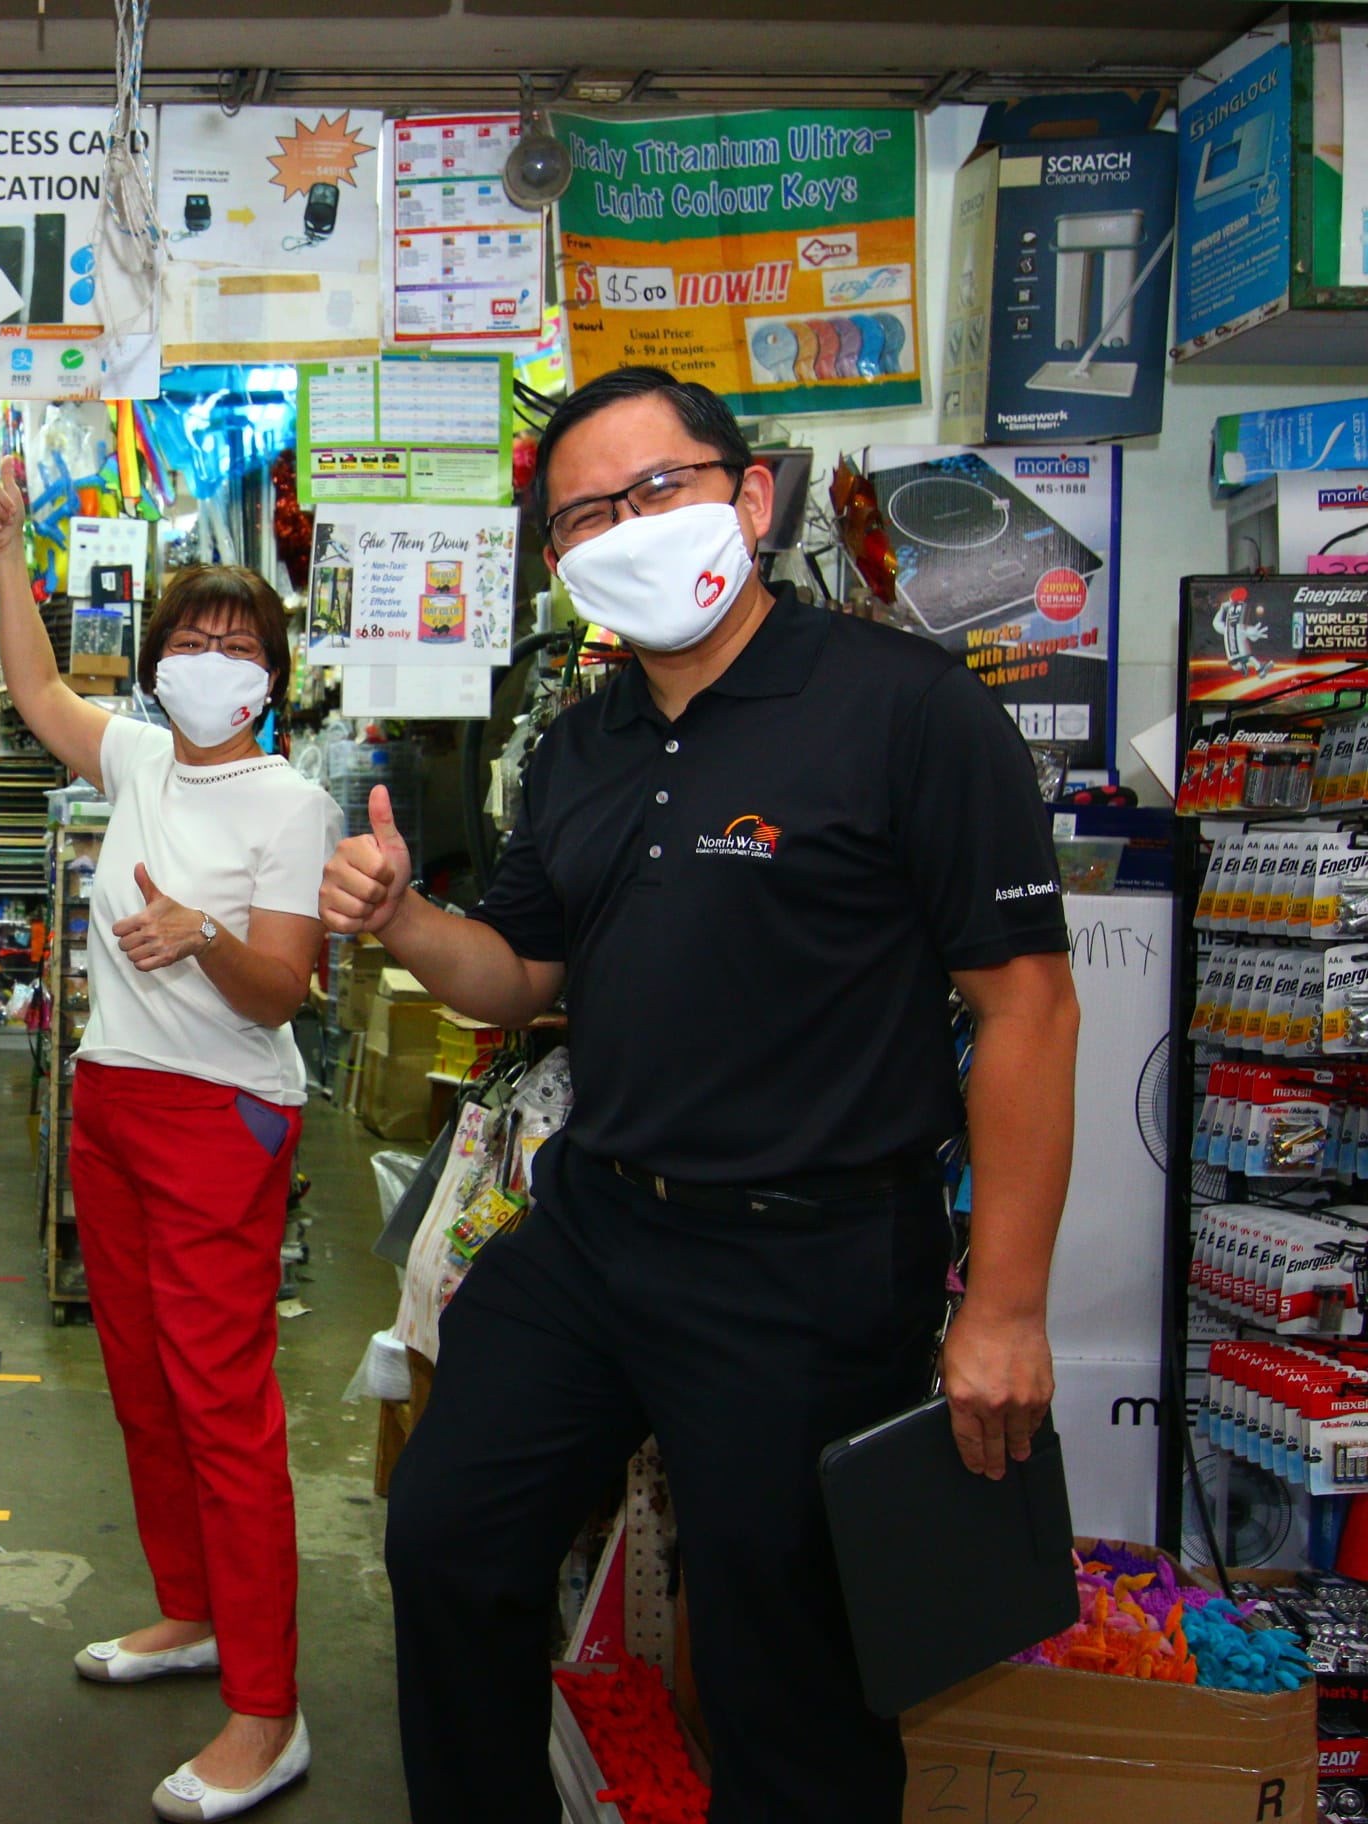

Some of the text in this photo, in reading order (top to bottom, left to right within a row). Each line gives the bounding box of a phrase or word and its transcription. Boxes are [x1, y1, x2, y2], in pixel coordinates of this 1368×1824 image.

[1206, 68, 1280, 130] SINGLOCK
[570, 125, 891, 180] Italy Titanium Ultra-
[1047, 152, 1131, 173] SCRATCH
[1045, 170, 1130, 186] Cleaning mop
[594, 173, 859, 223] Light Colour Keys
[605, 272, 667, 303] $5.00
[677, 261, 792, 306] now!!!
[630, 329, 660, 340] Usual
[644, 344, 656, 356] $9
[658, 346, 669, 355] at
[672, 345, 704, 357] major
[672, 359, 716, 371] Centres
[998, 409, 1068, 424] housework
[1016, 453, 1088, 477] morries
[1035, 484, 1087, 495] MS-1888
[359, 531, 470, 555] Glue Them Down
[371, 561, 408, 571] Non-Toxic
[370, 574, 404, 583] No Odour
[371, 586, 396, 595] Simple
[1293, 586, 1367, 607] Energizer
[370, 598, 402, 607] Effective
[1040, 594, 1082, 605] CERAMIC
[369, 609, 408, 618] Affordable
[1305, 612, 1368, 624] WORLD'S
[388, 629, 411, 640] only
[1305, 624, 1368, 636] LONGEST
[966, 624, 1022, 649] Works
[1305, 636, 1367, 648] LASTING
[966, 627, 1099, 670] with all types of
[1232, 729, 1313, 743] Energizer max
[1273, 1088, 1312, 1097] maxell
[1288, 1374, 1308, 1382] AAA
